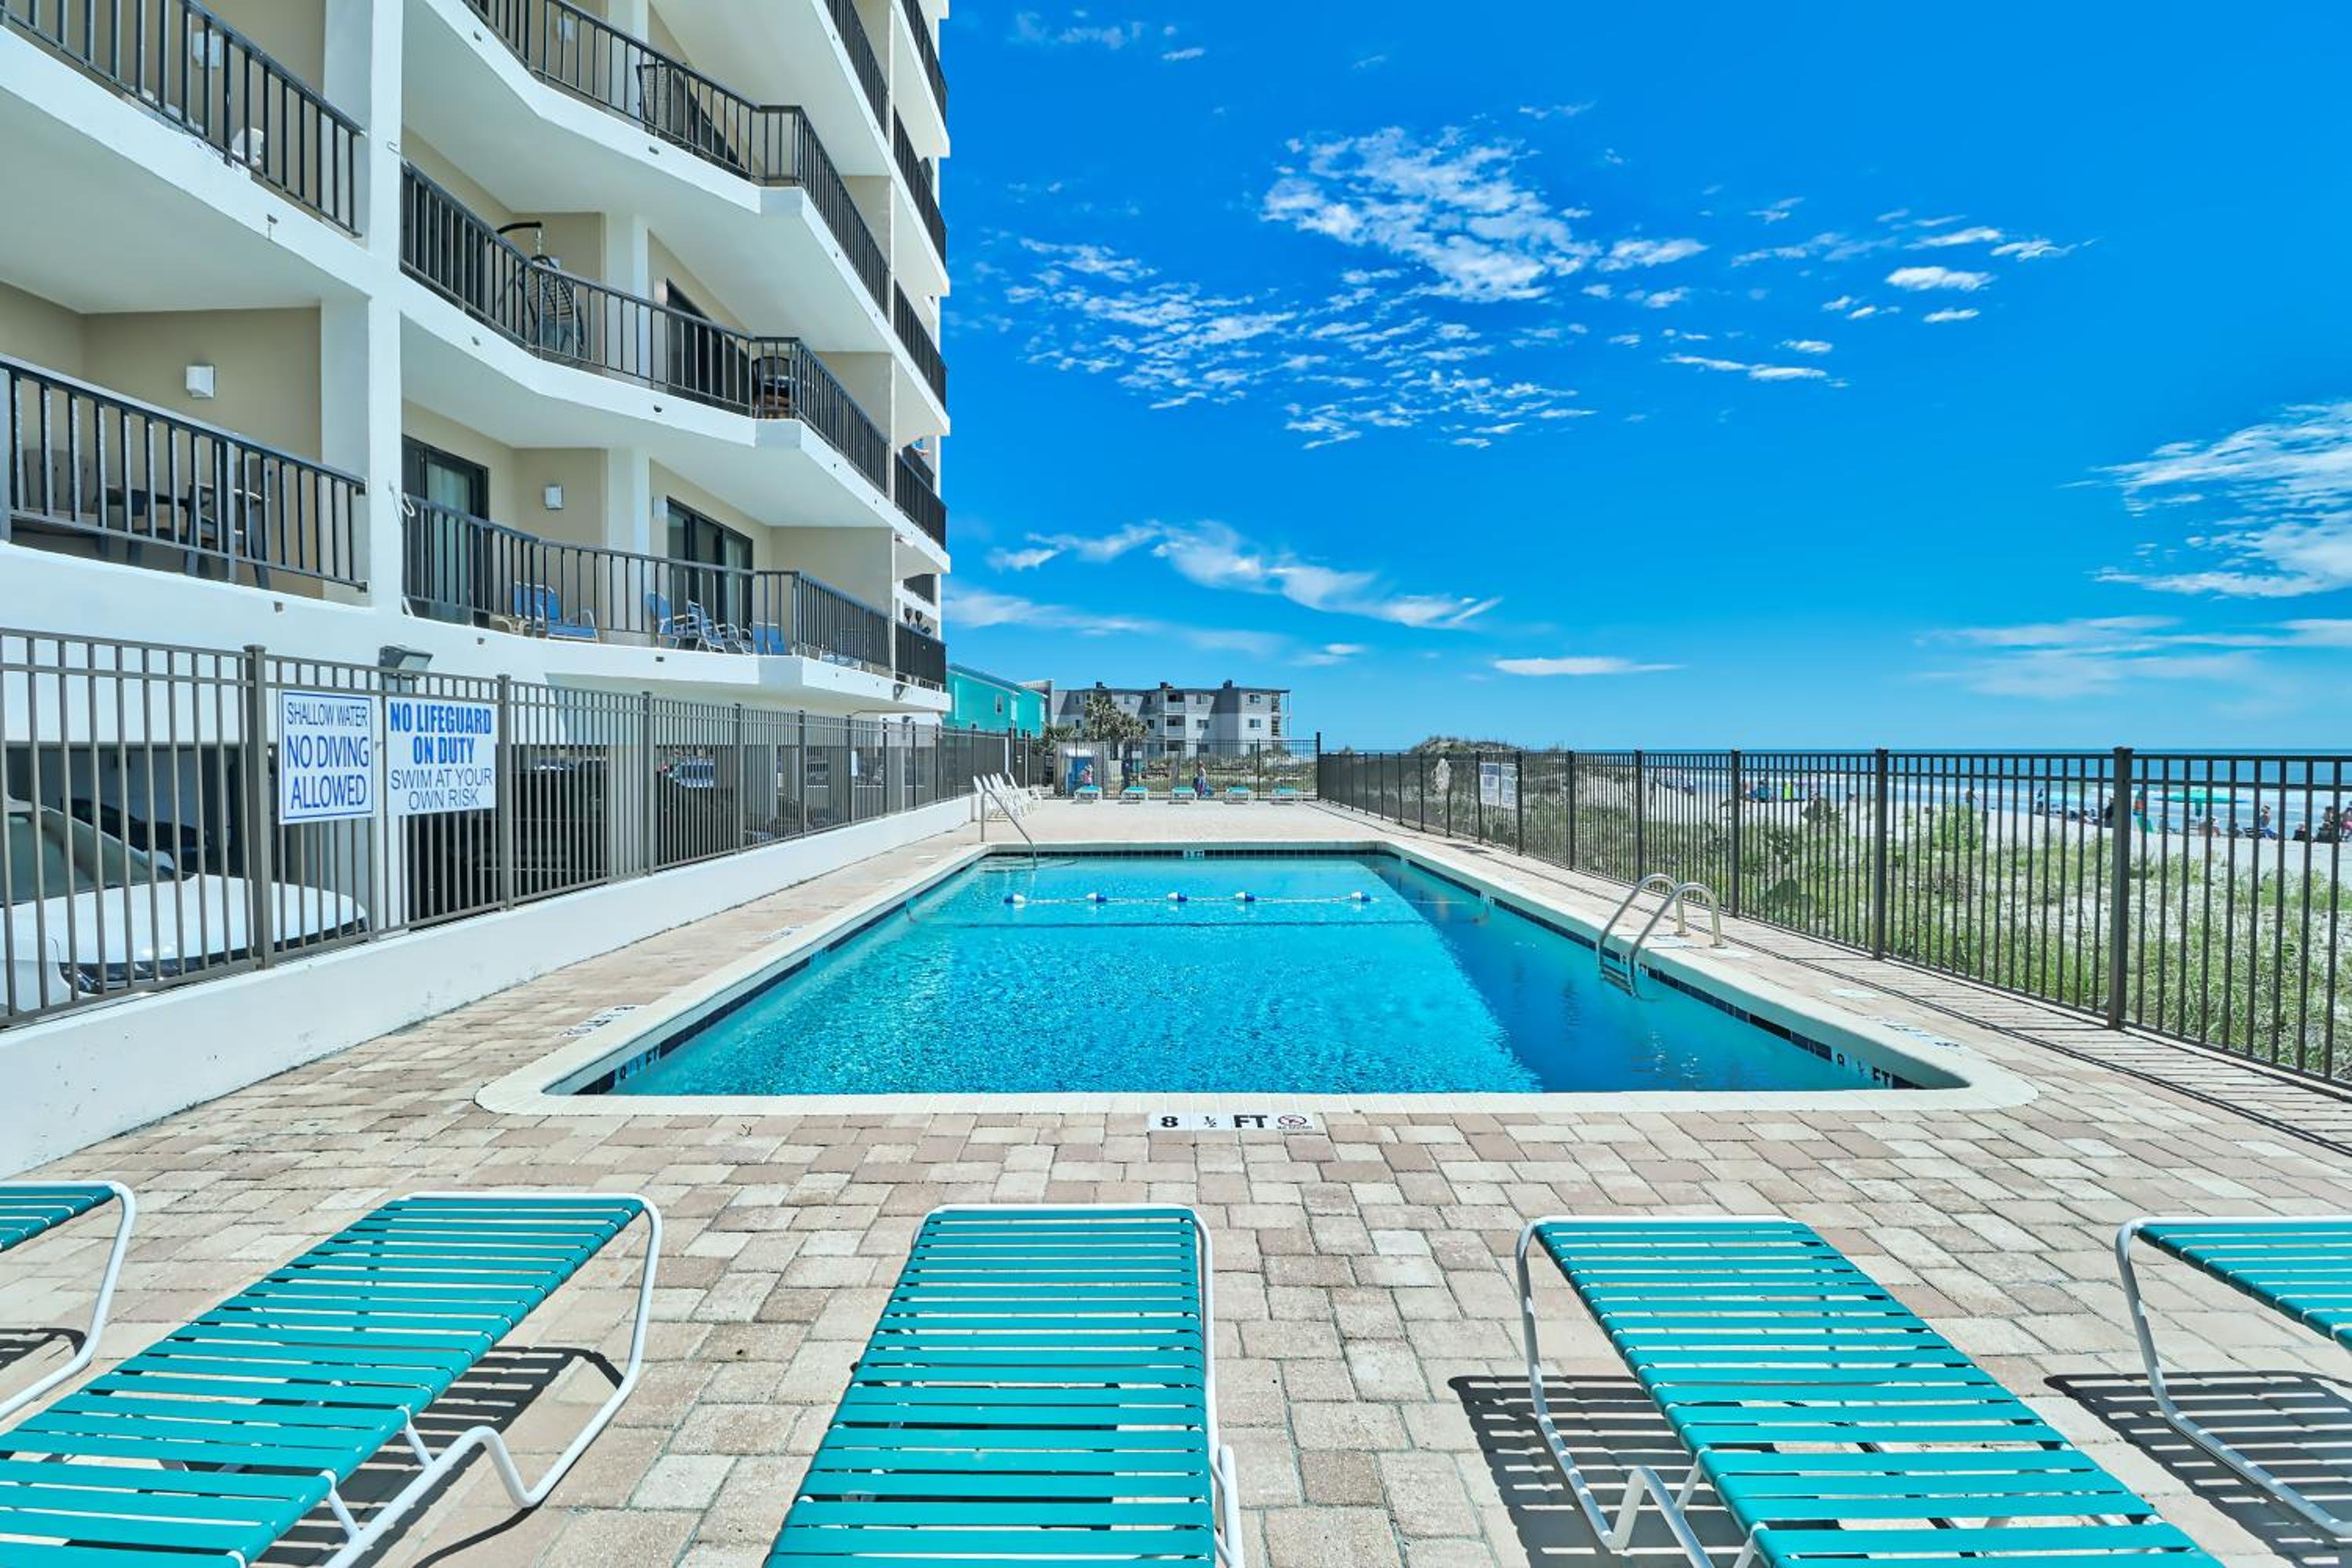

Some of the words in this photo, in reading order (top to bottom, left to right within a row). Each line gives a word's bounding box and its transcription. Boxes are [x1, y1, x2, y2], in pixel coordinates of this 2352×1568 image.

[287, 701, 334, 726] SHALLOW
[336, 703, 368, 728] WATER
[390, 702, 412, 733] NO
[416, 703, 492, 735] LIFEGUARD
[287, 734, 313, 769] NO
[317, 735, 370, 768] DIVING
[413, 735, 434, 765] ON
[438, 735, 475, 765] DUTY
[290, 774, 367, 810] ALLOWED
[390, 768, 433, 790] SWIM
[435, 768, 452, 788] AT
[455, 766, 493, 786] YOUR
[408, 789, 445, 811] OWN
[448, 786, 480, 808] RISK
[1160, 1115, 1179, 1128] 8
[1233, 1114, 1269, 1129] FT
